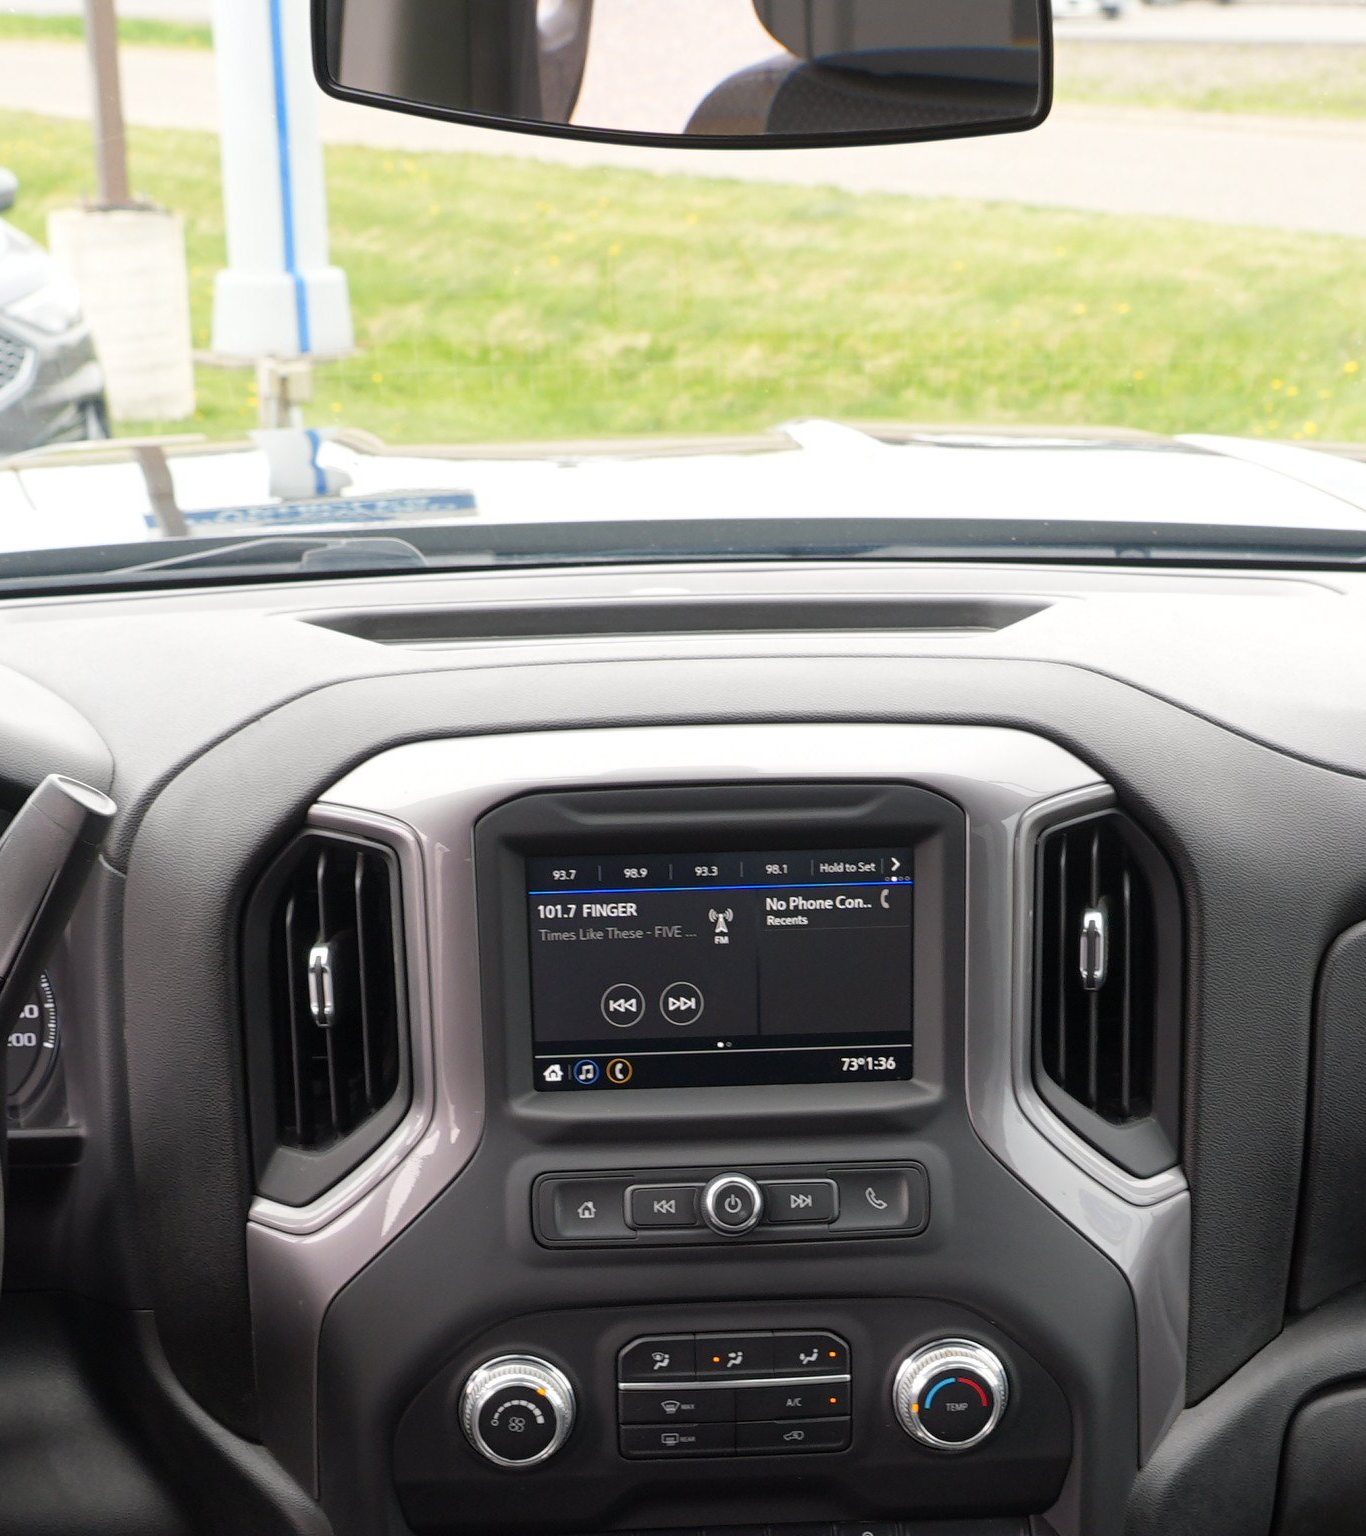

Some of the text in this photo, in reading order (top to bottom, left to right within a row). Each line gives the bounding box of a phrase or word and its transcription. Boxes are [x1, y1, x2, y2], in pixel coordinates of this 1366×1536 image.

[694, 866, 719, 877] 93.3
[765, 864, 788, 875] 98.1
[819, 862, 876, 873] Hold to Set
[552, 869, 577, 880] 93.7
[623, 868, 648, 879] 98.9
[766, 895, 872, 911] No Phone Con..
[537, 902, 638, 919] 101.7 FINGER
[766, 915, 809, 926] Recents
[539, 929, 577, 942] Times
[579, 927, 604, 940] Like
[605, 926, 644, 940] These
[654, 925, 683, 938] FIVE
[714, 936, 729, 945] FM
[866, 1056, 896, 1070] 1:36
[786, 1398, 803, 1407] A/C
[945, 1402, 969, 1412] TEMP
